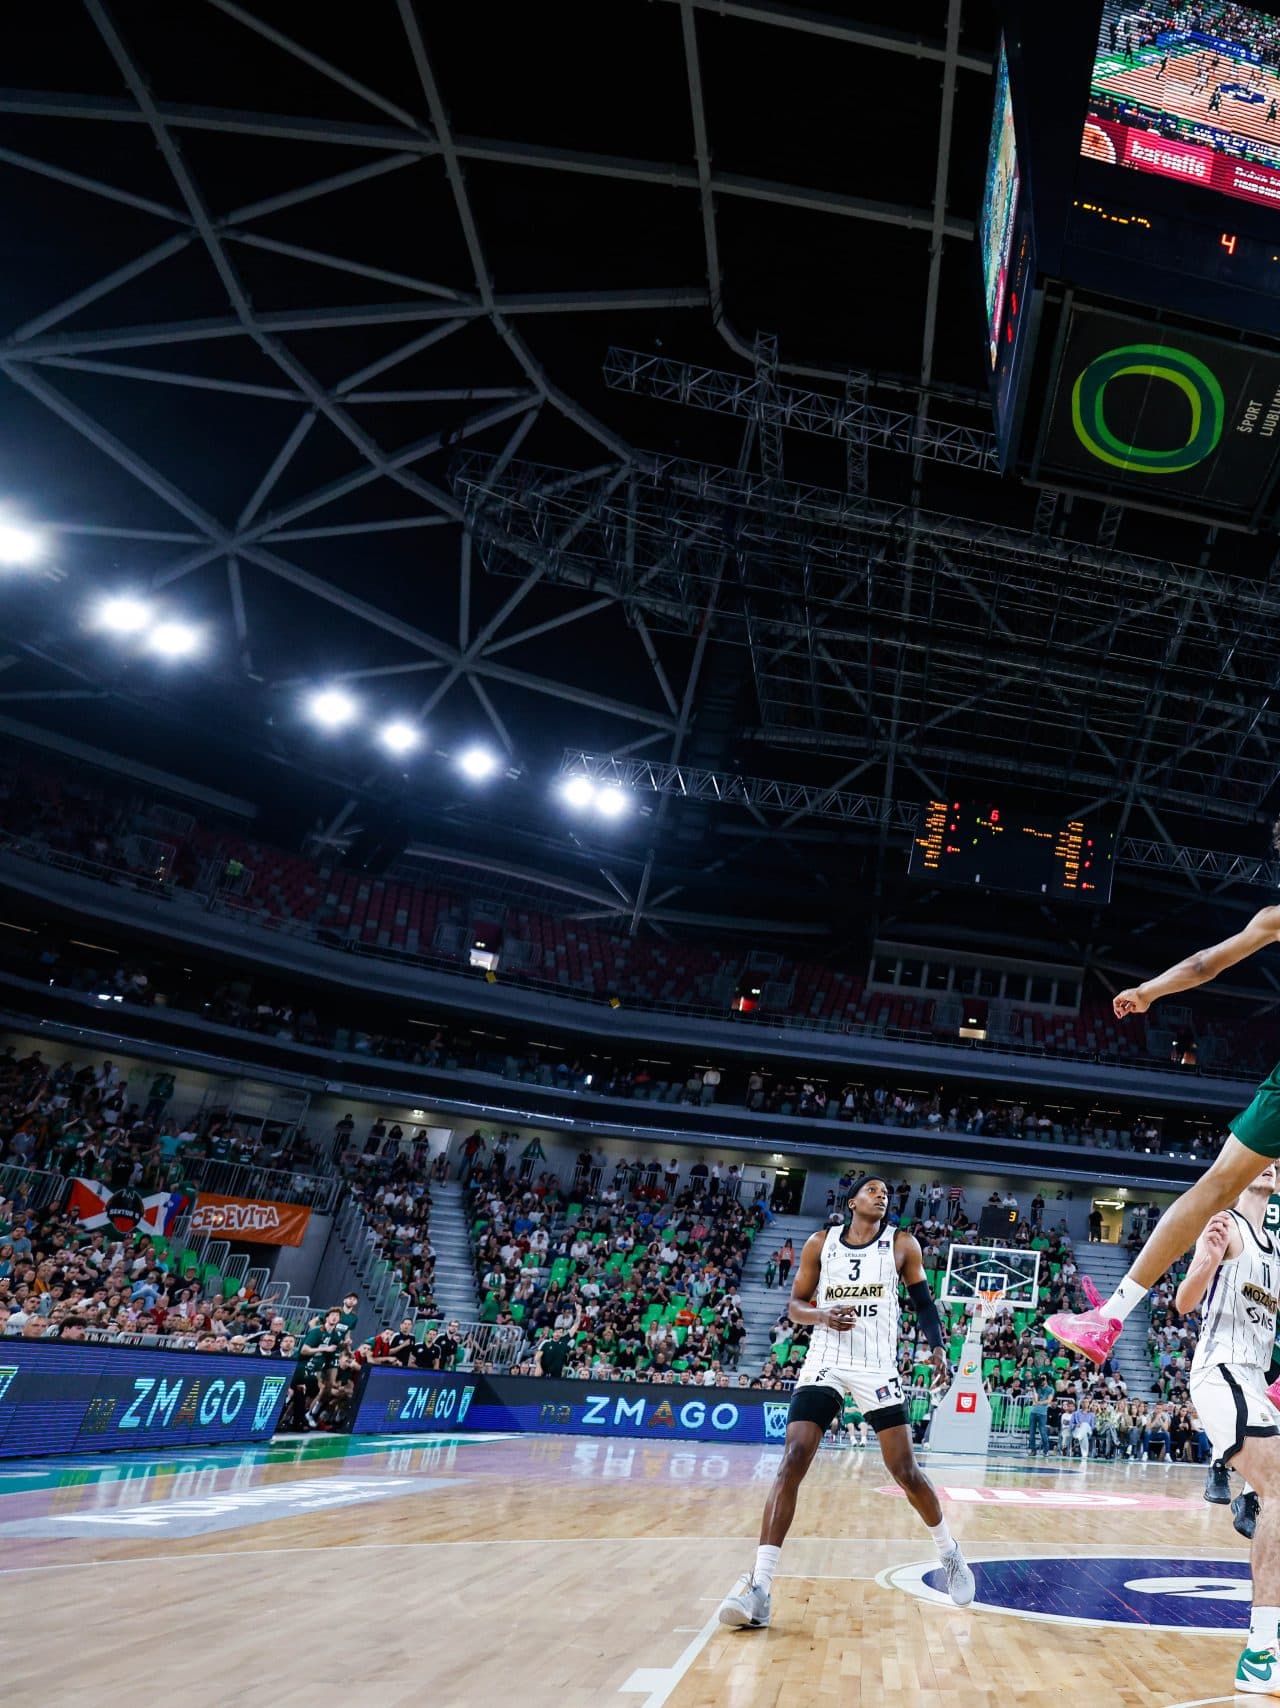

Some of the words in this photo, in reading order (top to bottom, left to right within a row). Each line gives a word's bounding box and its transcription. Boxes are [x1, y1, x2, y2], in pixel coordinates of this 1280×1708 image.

[1221, 233, 1236, 255] 4
[1236, 400, 1263, 433] ŠPORT
[190, 1205, 279, 1230] CEDEVITA
[1008, 1210, 1017, 1223] 3
[1266, 1203, 1280, 1224] 9
[848, 1259, 861, 1281] 3
[1261, 1261, 1271, 1289] 11
[825, 1285, 884, 1301] MOZZART
[888, 1377, 902, 1398] 3
[118, 1378, 246, 1430] ZMAGO
[400, 1387, 456, 1418] ZMAGO
[582, 1395, 738, 1430] ZMAGO
